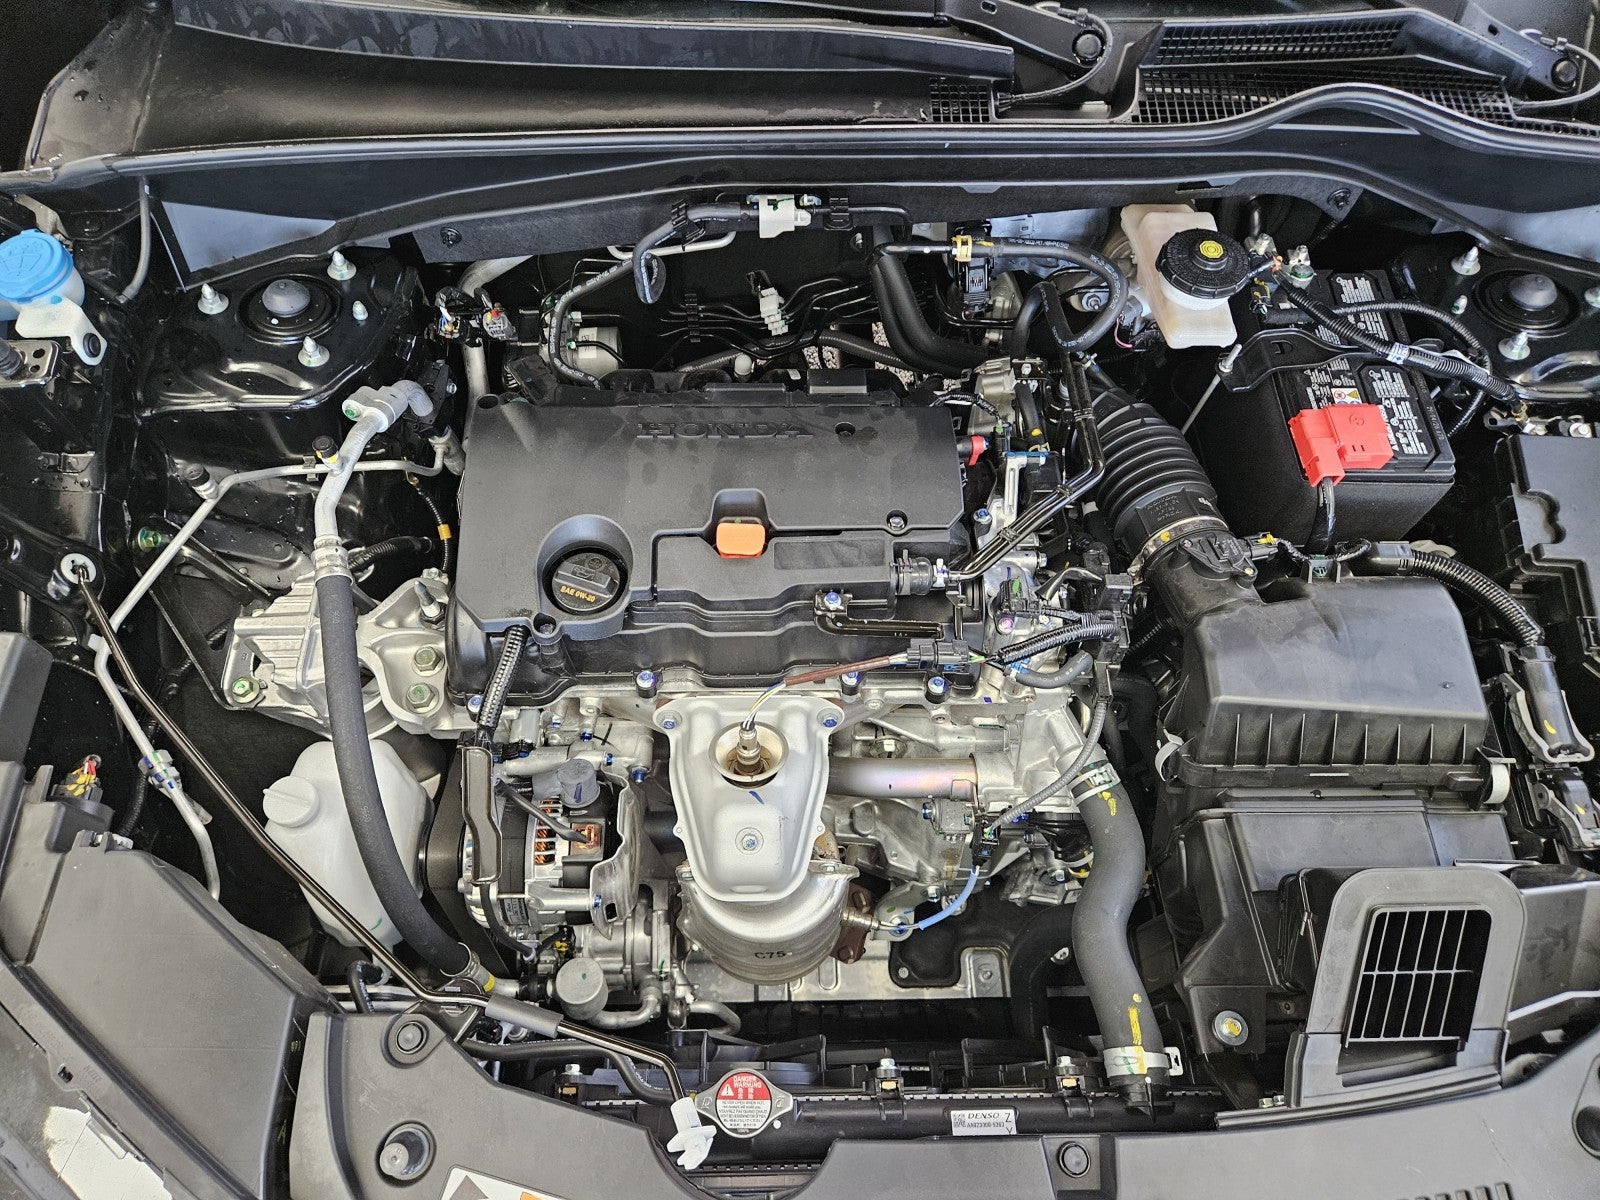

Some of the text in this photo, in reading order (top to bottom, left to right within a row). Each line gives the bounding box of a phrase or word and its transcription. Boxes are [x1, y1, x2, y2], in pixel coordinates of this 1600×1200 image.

[636, 422, 815, 439] HONDA
[560, 585, 596, 603] SAE 0W-20
[754, 950, 786, 959] C75
[967, 1112, 1000, 1120] DENSO
